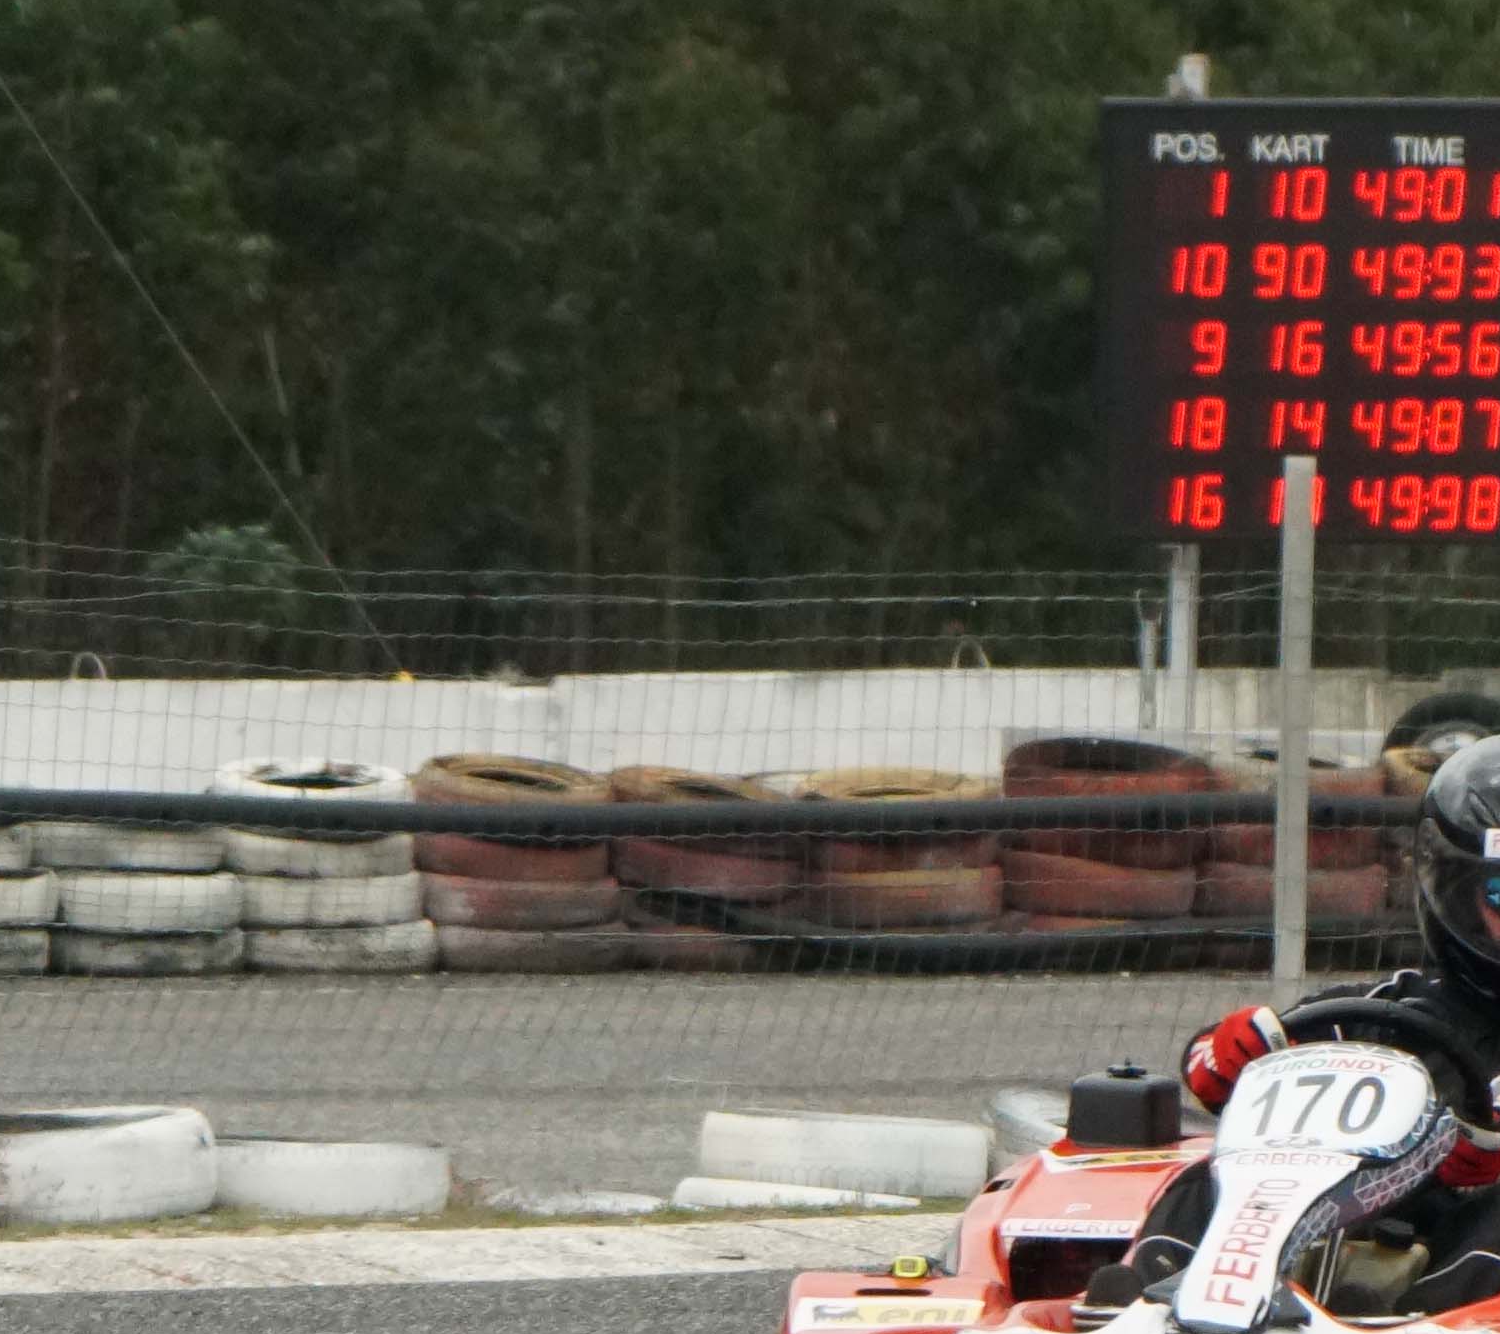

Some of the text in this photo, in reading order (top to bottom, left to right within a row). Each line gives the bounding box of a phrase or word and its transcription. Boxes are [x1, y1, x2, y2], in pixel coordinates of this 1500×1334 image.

[1153, 133, 1224, 162] POS.
[1252, 134, 1329, 162] KART
[1393, 136, 1465, 165] TIME
[1211, 170, 1229, 218] 1
[1271, 167, 1328, 222] 10
[1172, 243, 1229, 298] 10
[1253, 243, 1328, 299] 90
[1191, 321, 1228, 376] 9
[1269, 321, 1325, 377] 16
[1171, 397, 1227, 452] 18
[1270, 400, 1327, 450] 14
[1169, 474, 1225, 530] 16
[1251, 1074, 1386, 1136] 170
[1204, 1169, 1300, 1307] FERBERTO
[877, 1307, 967, 1324] eni
